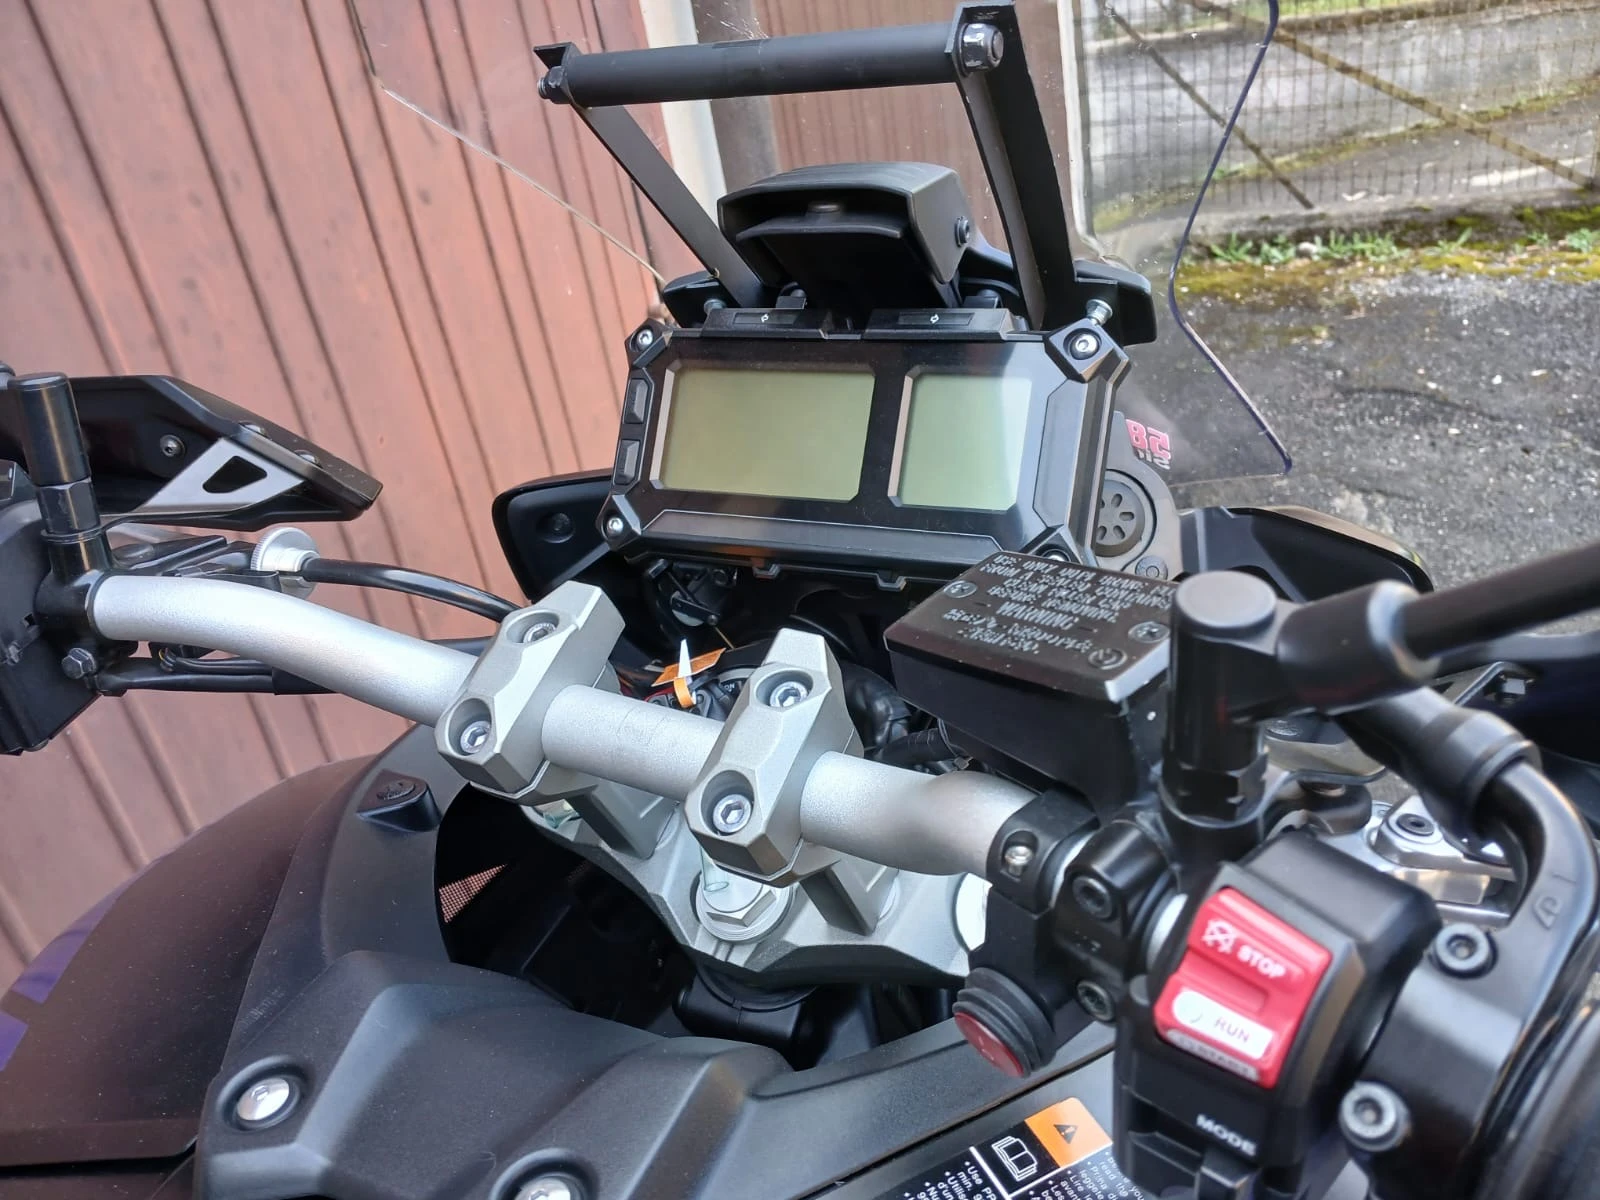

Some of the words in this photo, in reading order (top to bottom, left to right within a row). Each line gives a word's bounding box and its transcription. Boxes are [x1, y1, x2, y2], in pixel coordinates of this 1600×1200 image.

[995, 601, 1080, 630] WARNING
[1236, 944, 1286, 977] STOP
[1214, 1015, 1249, 1043] RUN
[1196, 1113, 1257, 1157] MODE
[957, 1171, 973, 1191] min.
[967, 1165, 983, 1185] Use
[1070, 1174, 1084, 1192] Lire
[1099, 1161, 1117, 1181] read
[1115, 1182, 1129, 1197] the
